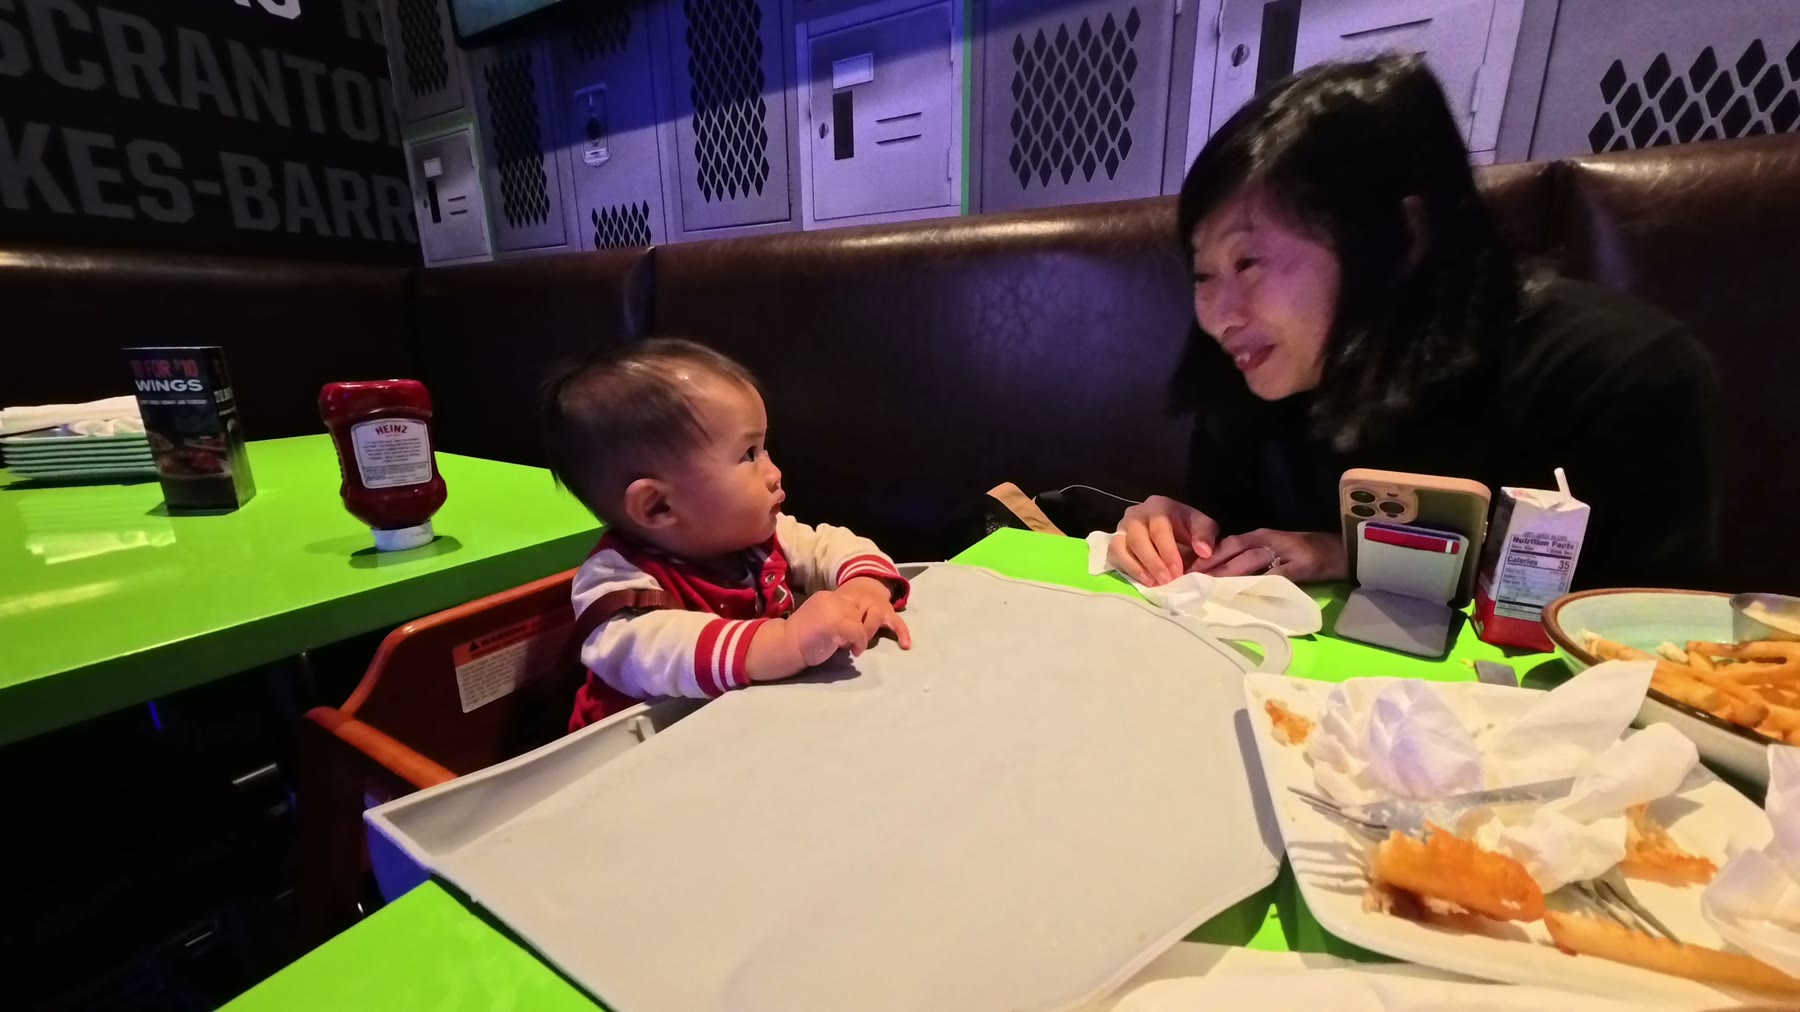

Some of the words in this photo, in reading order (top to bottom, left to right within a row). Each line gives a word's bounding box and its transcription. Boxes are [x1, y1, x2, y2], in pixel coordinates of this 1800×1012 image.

[134, 379, 203, 392] WINGS
[375, 424, 408, 436] HEINZ
[1513, 537, 1549, 547] Nutrition
[1552, 540, 1574, 550] Facts
[1508, 556, 1538, 566] Calories
[1558, 559, 1570, 570] 35
